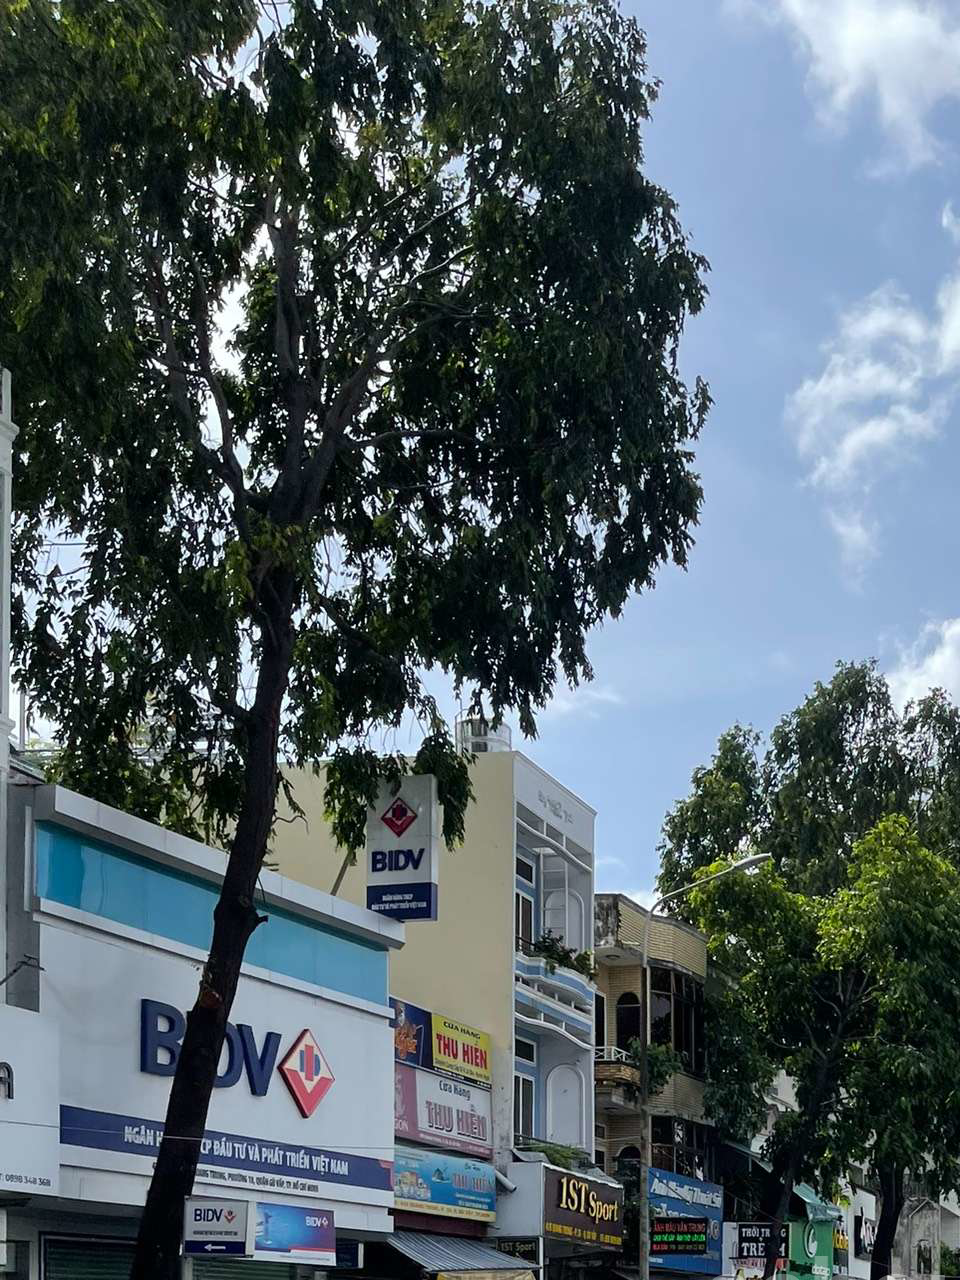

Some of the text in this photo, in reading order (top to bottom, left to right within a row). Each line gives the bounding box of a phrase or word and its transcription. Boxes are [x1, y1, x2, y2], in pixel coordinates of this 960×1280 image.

[371, 848, 425, 872] BIDV
[141, 998, 282, 1096] BDV
[436, 1033, 459, 1060] THU
[426, 1100, 454, 1133] THU
[124, 1125, 154, 1147] NGÂN
[233, 1142, 248, 1160] TƯ
[248, 1144, 261, 1162] VÀ
[261, 1146, 284, 1166] PHÁT
[311, 1154, 329, 1175] VIỆT
[330, 1160, 349, 1176] NAM
[560, 1176, 588, 1213] 1ST
[588, 1191, 618, 1223] Sport
[193, 1208, 223, 1222] BIDV
[305, 1216, 322, 1227] BIDV
[514, 1241, 536, 1253] Sport
